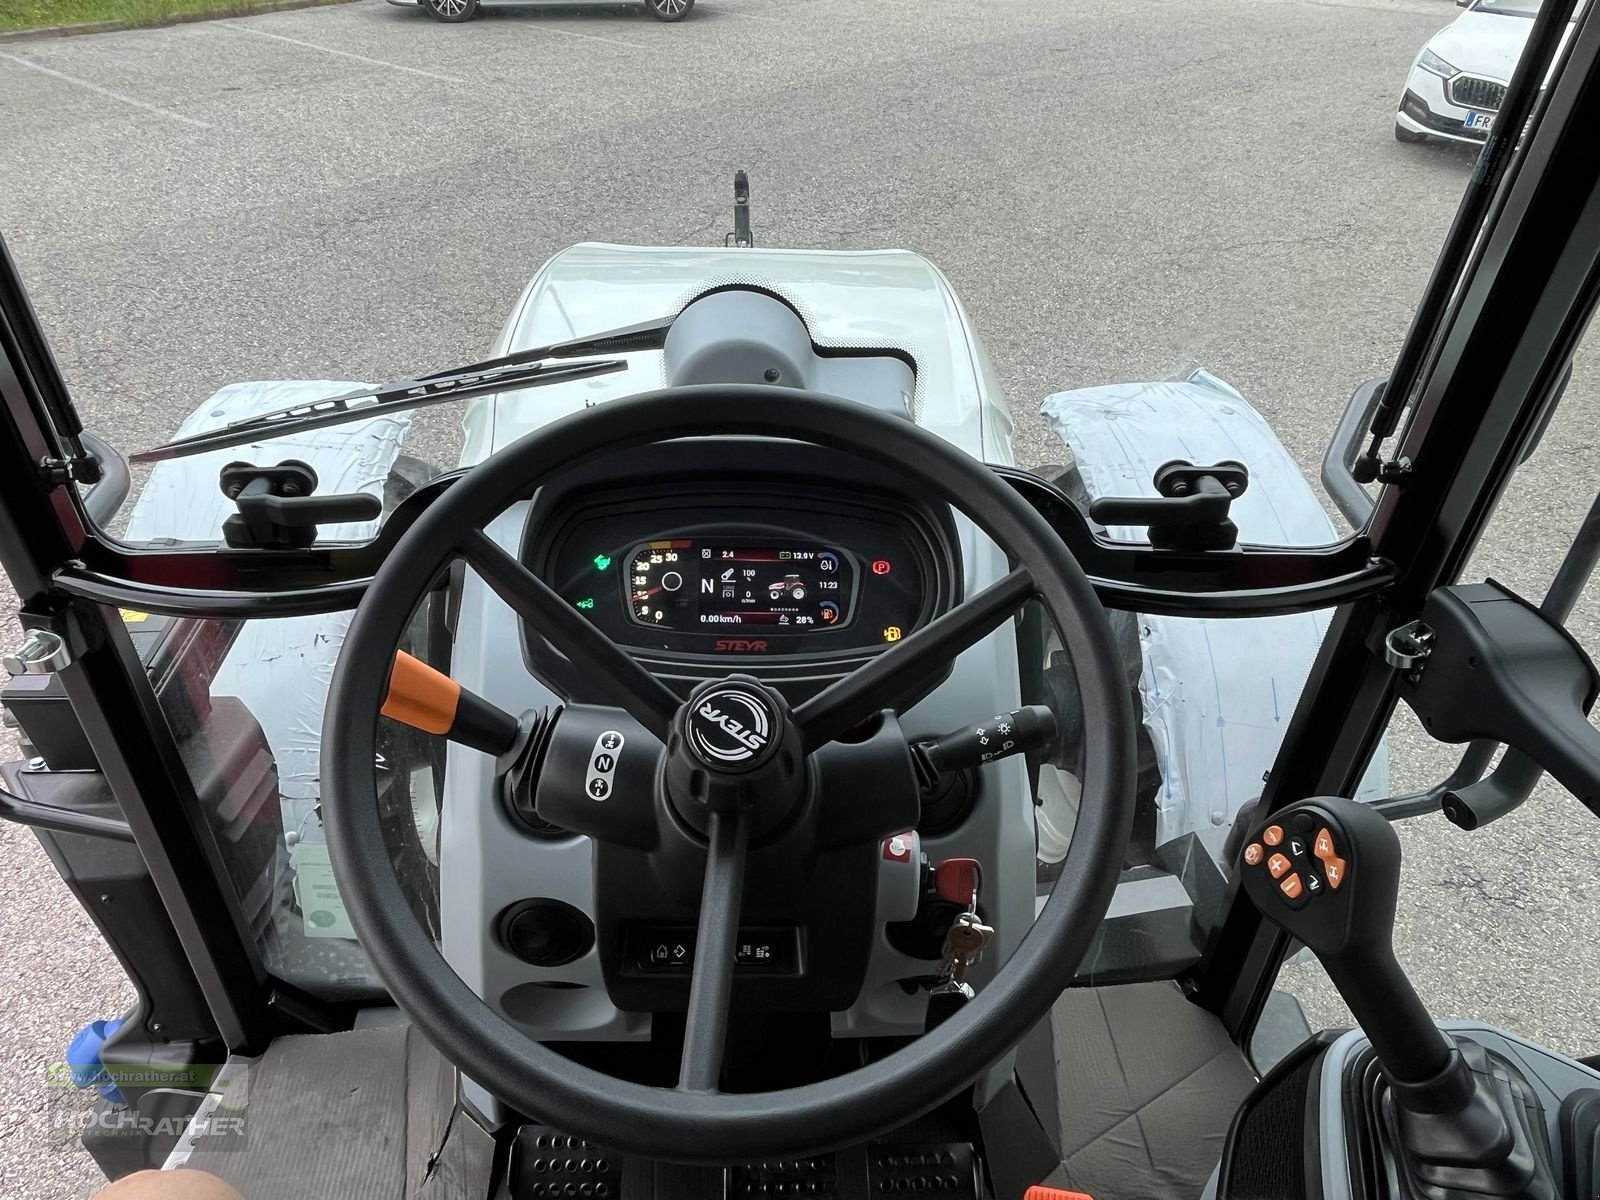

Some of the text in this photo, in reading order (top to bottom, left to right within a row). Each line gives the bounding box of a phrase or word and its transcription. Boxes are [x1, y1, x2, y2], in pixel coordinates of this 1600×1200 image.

[650, 554, 663, 564] 25
[665, 553, 678, 562] 30
[636, 562, 650, 571] 20
[743, 569, 756, 577] 100
[635, 576, 647, 585] 15
[701, 578, 714, 594] N
[745, 590, 751, 598] 0
[641, 606, 649, 615] 5
[655, 611, 663, 620] 0
[795, 616, 814, 624] 28%
[714, 640, 768, 651] STEYR
[699, 702, 767, 750] STEYR
[597, 756, 611, 771] N
